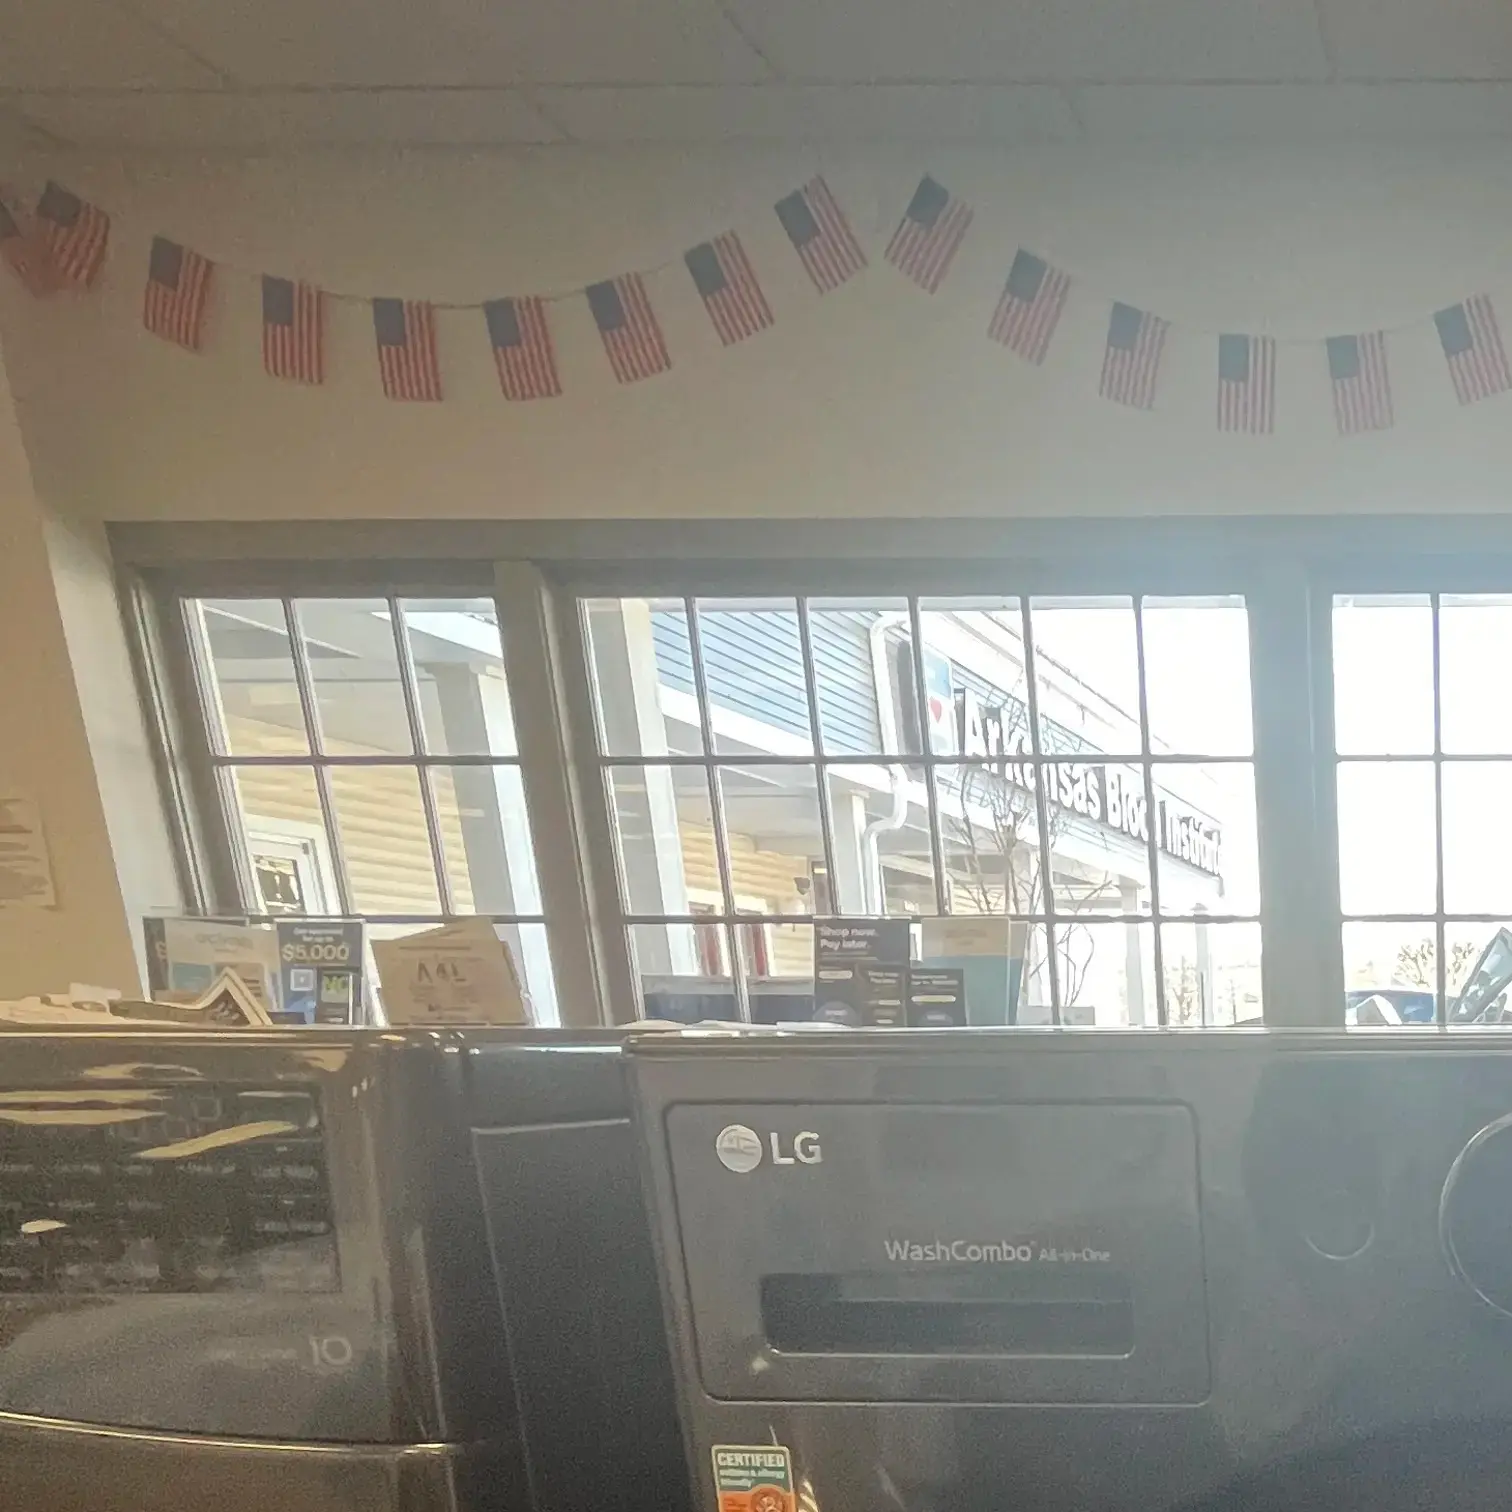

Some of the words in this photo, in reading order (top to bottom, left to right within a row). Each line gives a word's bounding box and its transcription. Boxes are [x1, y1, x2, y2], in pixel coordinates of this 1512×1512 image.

[770, 1130, 822, 1165] LG
[884, 1240, 1032, 1262] WashCombo
[717, 1453, 785, 1467] CERTIFIED
